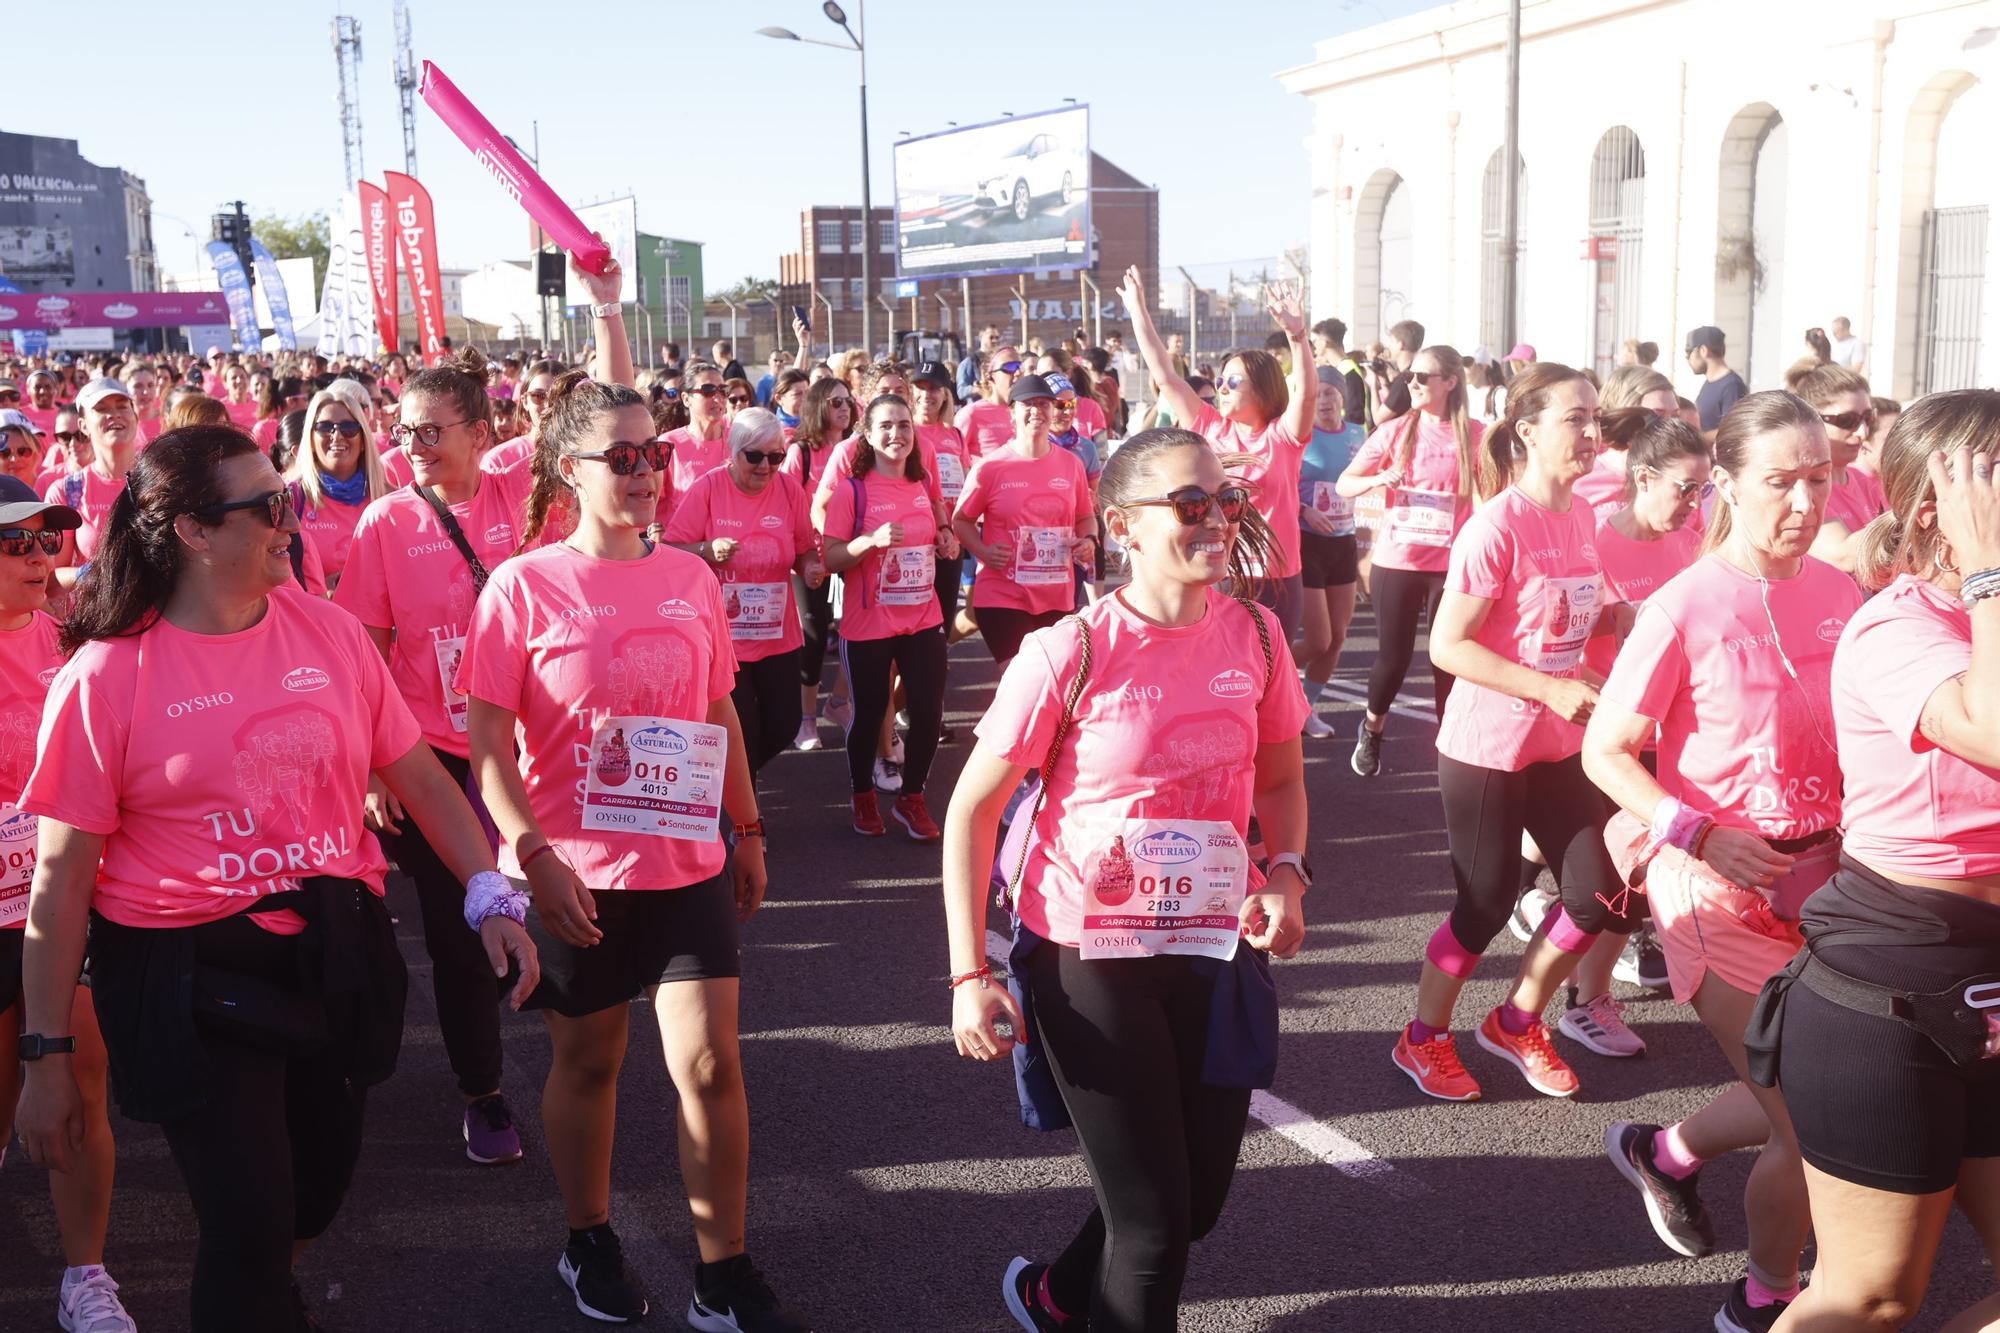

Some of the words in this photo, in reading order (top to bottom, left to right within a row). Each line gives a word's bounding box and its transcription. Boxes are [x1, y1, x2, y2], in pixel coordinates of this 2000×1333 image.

[305, 522, 338, 530] OYSHO
[408, 538, 453, 558] OYSHO
[1038, 549, 1056, 558] 016
[902, 568, 923, 578] 016
[561, 605, 617, 620] OYSHO
[742, 605, 765, 615] 016
[1570, 611, 1590, 627] 016
[166, 691, 234, 718] OYSHO
[634, 735, 683, 751] ASTURIANA
[693, 739, 718, 747] SUMA
[635, 762, 678, 782] 016
[641, 783, 668, 796] 4013
[601, 796, 638, 808] CARRERA
[638, 800, 651, 808] DE
[651, 801, 661, 809] LA
[662, 802, 688, 813] MUJER
[689, 806, 708, 815] 2023
[203, 807, 256, 841] TU
[595, 811, 637, 824] OYSHO
[668, 820, 709, 833] Santander
[1140, 842, 1197, 856] ASTURIANA
[1207, 839, 1238, 848] SUMA
[218, 826, 351, 883] DORSAL
[1139, 876, 1193, 895] 016
[1147, 900, 1181, 912] 2193
[1100, 918, 1142, 927] CARRERA
[1144, 919, 1157, 927] DE
[1160, 919, 1171, 927] LA
[1172, 918, 1202, 927] MUJER
[1204, 918, 1227, 926] 2023
[1094, 936, 1142, 948] OYSHO
[1178, 934, 1227, 947] Santander
